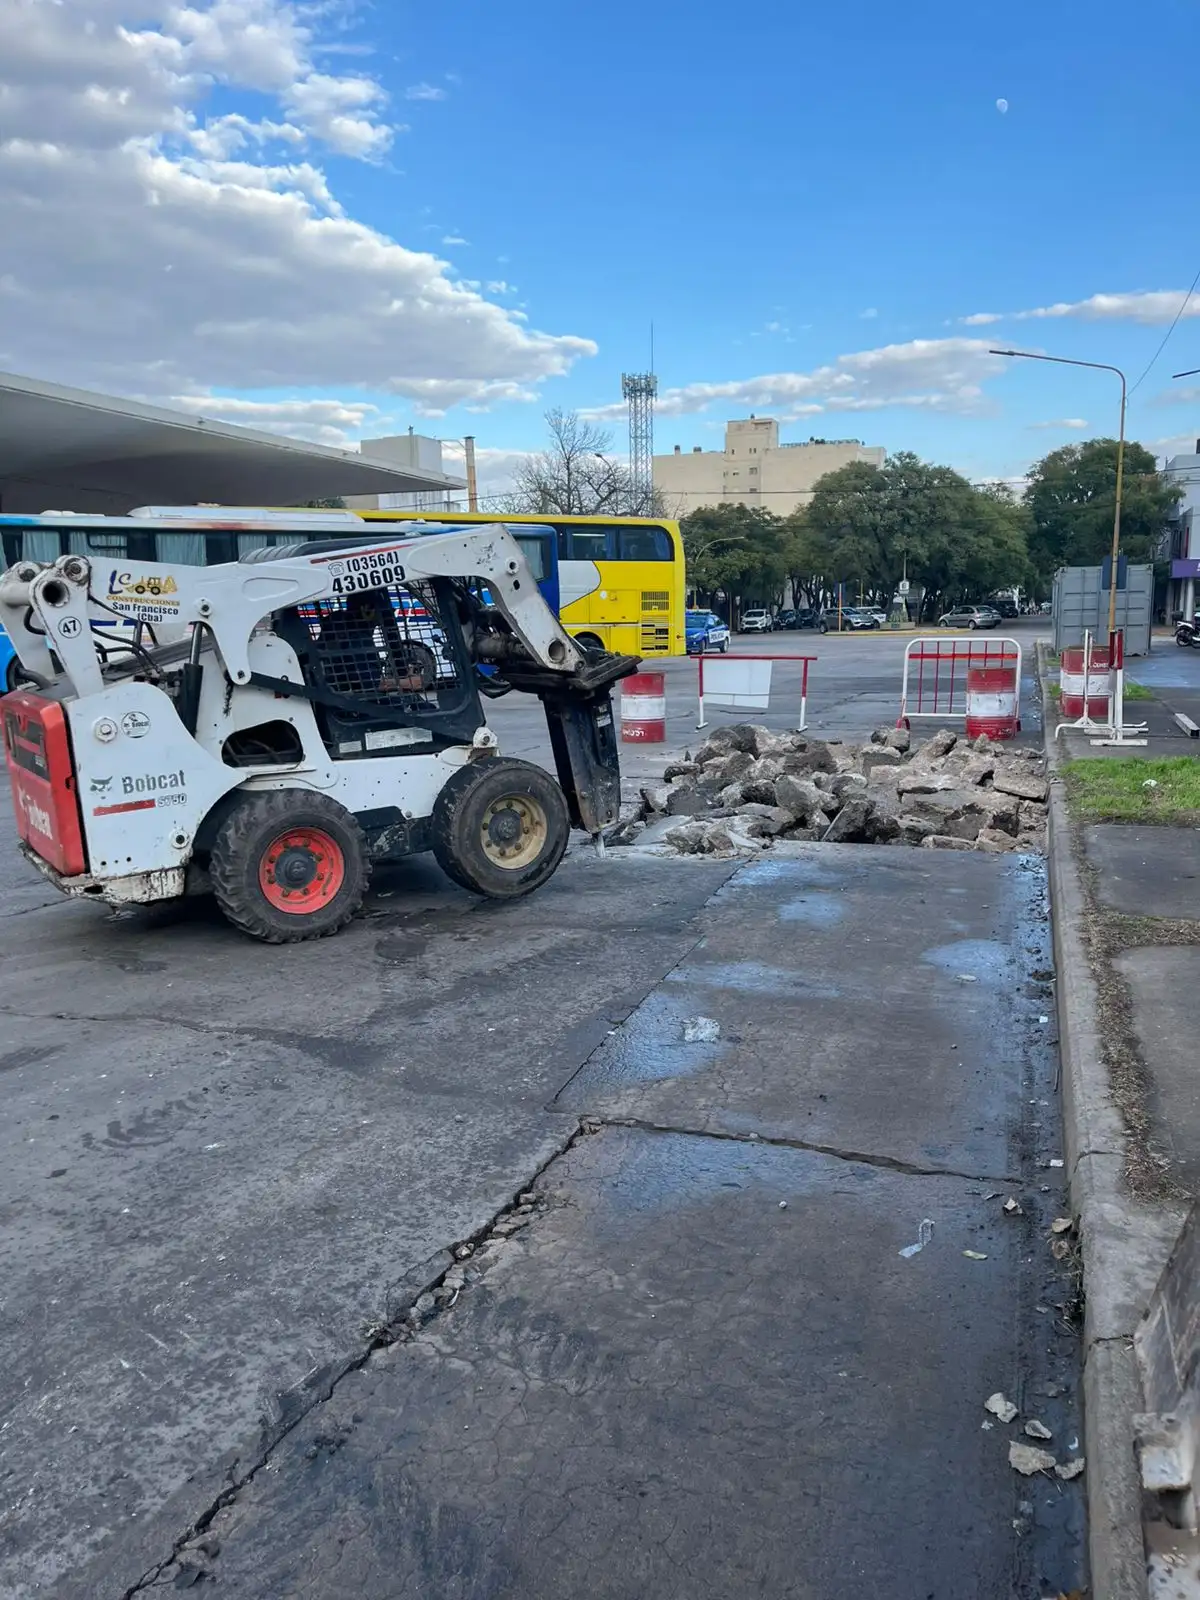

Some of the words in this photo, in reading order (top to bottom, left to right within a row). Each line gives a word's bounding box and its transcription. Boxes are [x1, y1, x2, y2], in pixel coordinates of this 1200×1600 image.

[346, 551, 399, 573] (03564)
[332, 565, 406, 593] 430609
[106, 595, 180, 607] CONSTRUCCIONES
[112, 602, 131, 612] San
[132, 604, 179, 616] Francisco
[137, 612, 163, 623] (Cba)
[62, 619, 78, 634] 47
[121, 769, 186, 795] Bobcat
